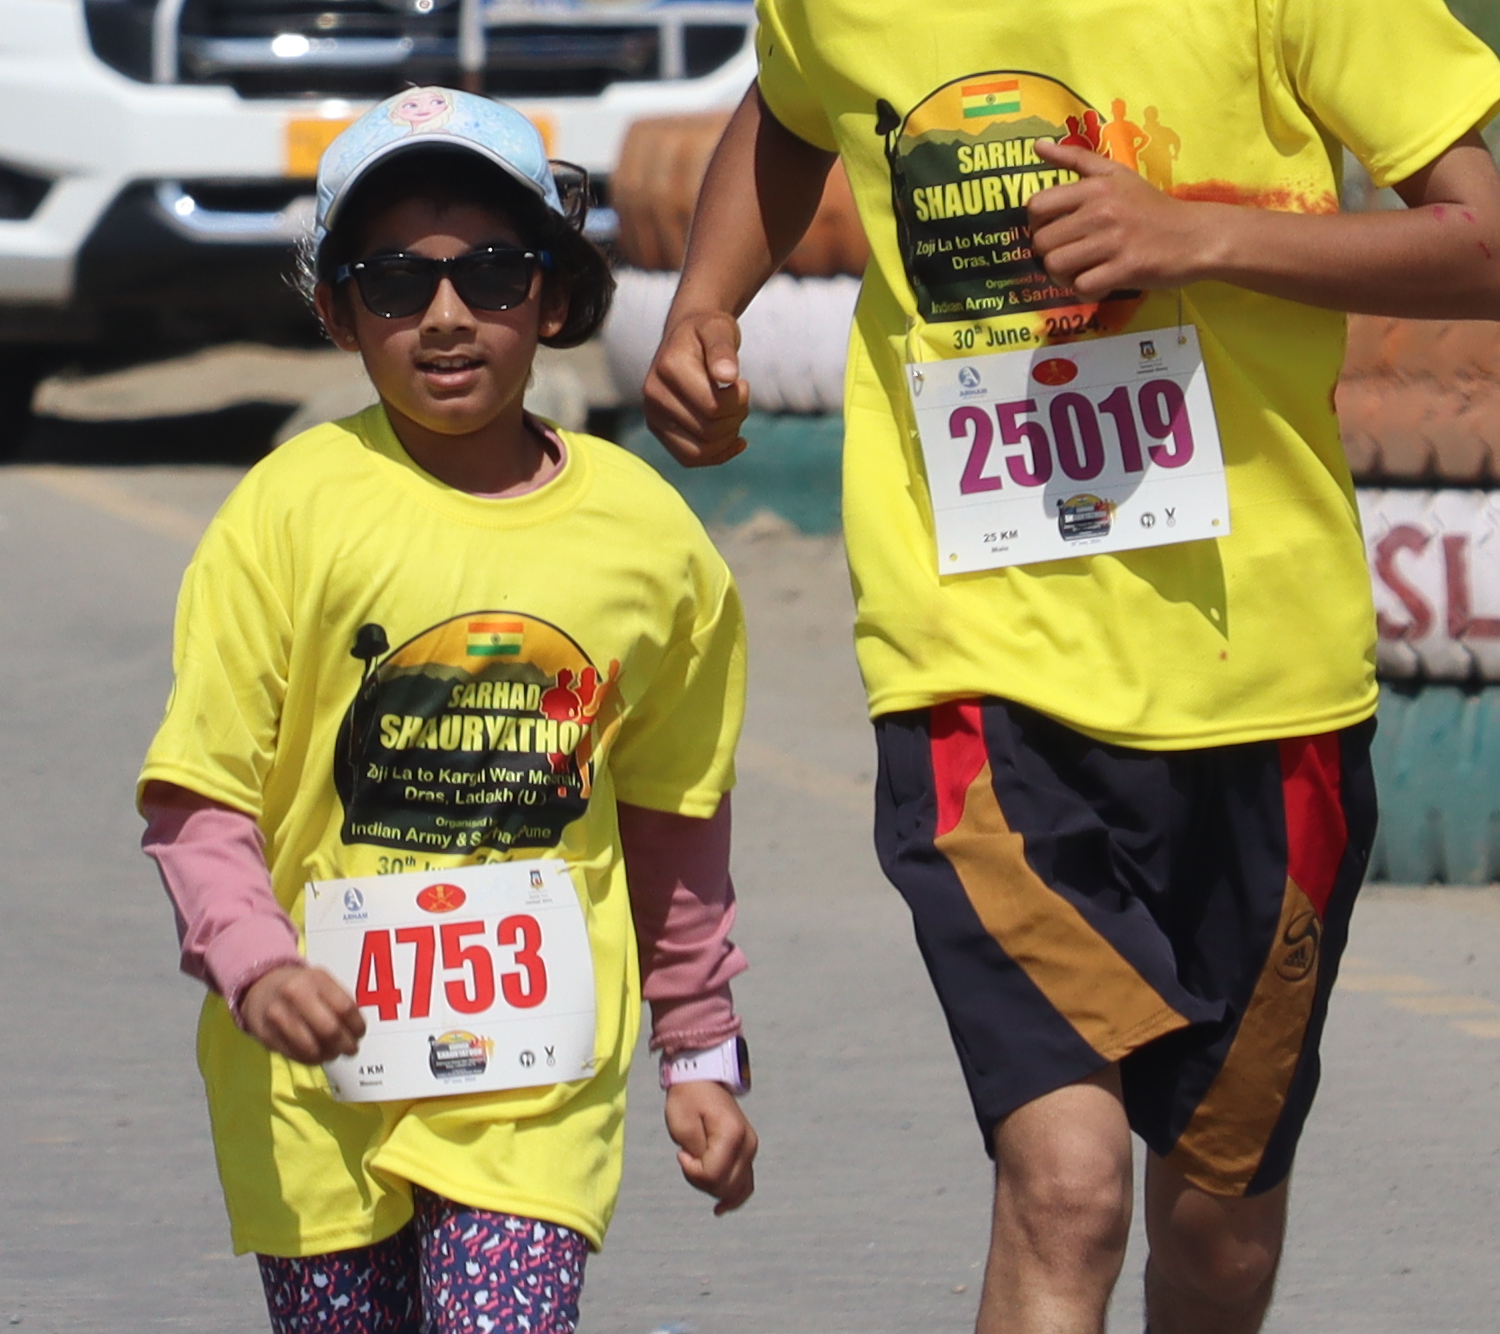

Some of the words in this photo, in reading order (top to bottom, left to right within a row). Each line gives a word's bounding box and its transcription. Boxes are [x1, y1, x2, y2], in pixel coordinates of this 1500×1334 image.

[957, 136, 1056, 175] SARHA
[938, 238, 953, 253] La
[955, 235, 971, 250] to
[973, 227, 1019, 247] Kargil
[991, 246, 1034, 265] Lada
[964, 293, 1005, 311] Army
[1008, 290, 1019, 305] &
[948, 378, 1196, 496] 25019
[983, 531, 997, 543] 25
[1000, 529, 1019, 541] KM
[448, 681, 542, 711] SARHAD
[391, 766, 412, 781] La
[417, 767, 434, 782] to
[438, 767, 486, 787] Kargil
[489, 767, 525, 783] War
[404, 785, 449, 805] Dras,
[455, 788, 514, 805] Ladakh
[351, 822, 401, 840] Indian
[404, 827, 453, 849] Army
[456, 832, 467, 847] &
[354, 913, 548, 1022] 4753
[358, 1065, 365, 1075] 4
[367, 1063, 384, 1075] KM
